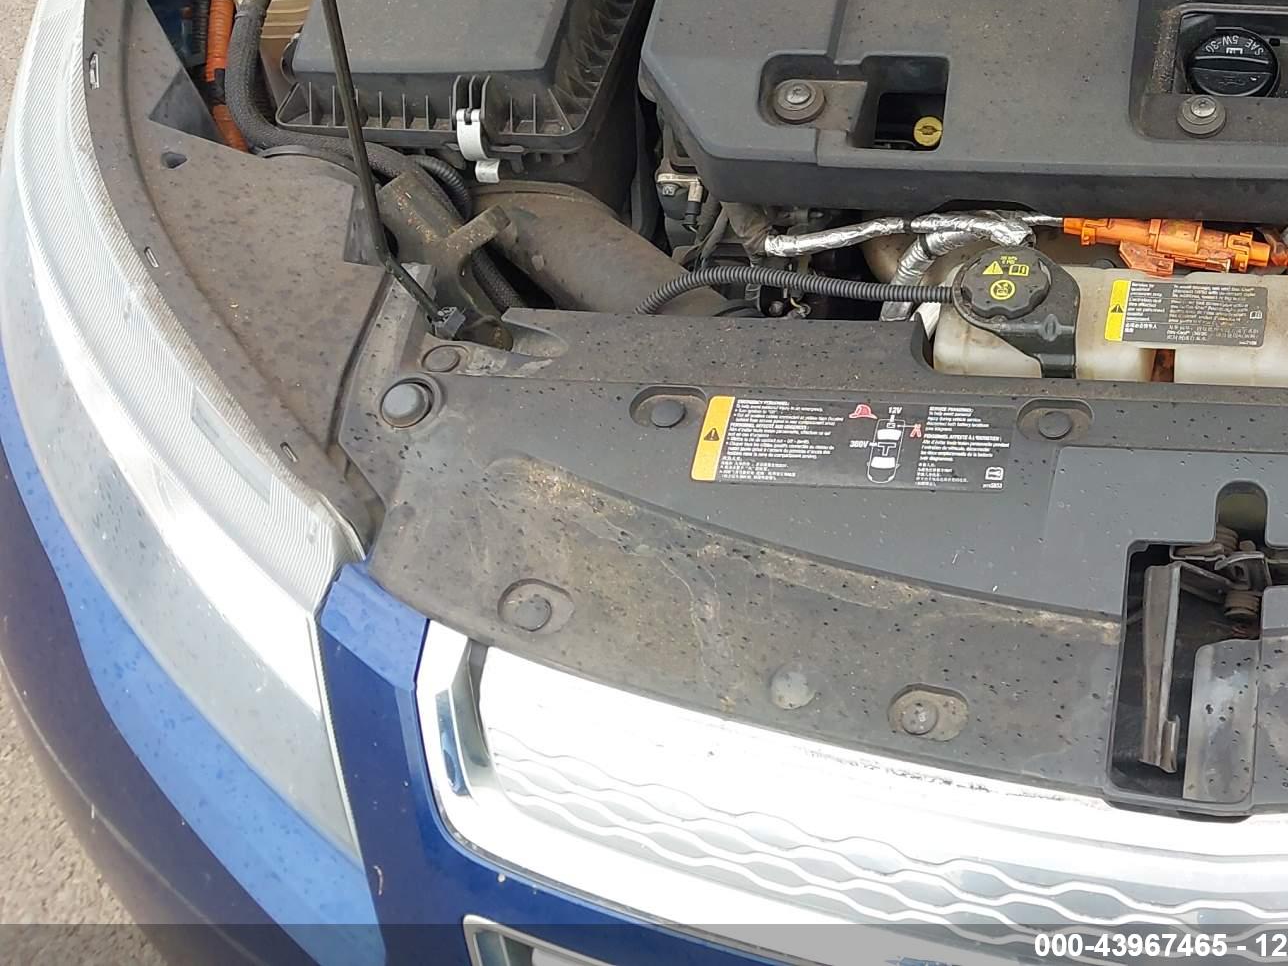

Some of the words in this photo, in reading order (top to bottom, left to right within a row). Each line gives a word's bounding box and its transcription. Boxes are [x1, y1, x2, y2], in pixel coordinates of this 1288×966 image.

[1205, 35, 1240, 53] 5W-30
[1244, 38, 1264, 55] SAE
[888, 406, 903, 414] 12V
